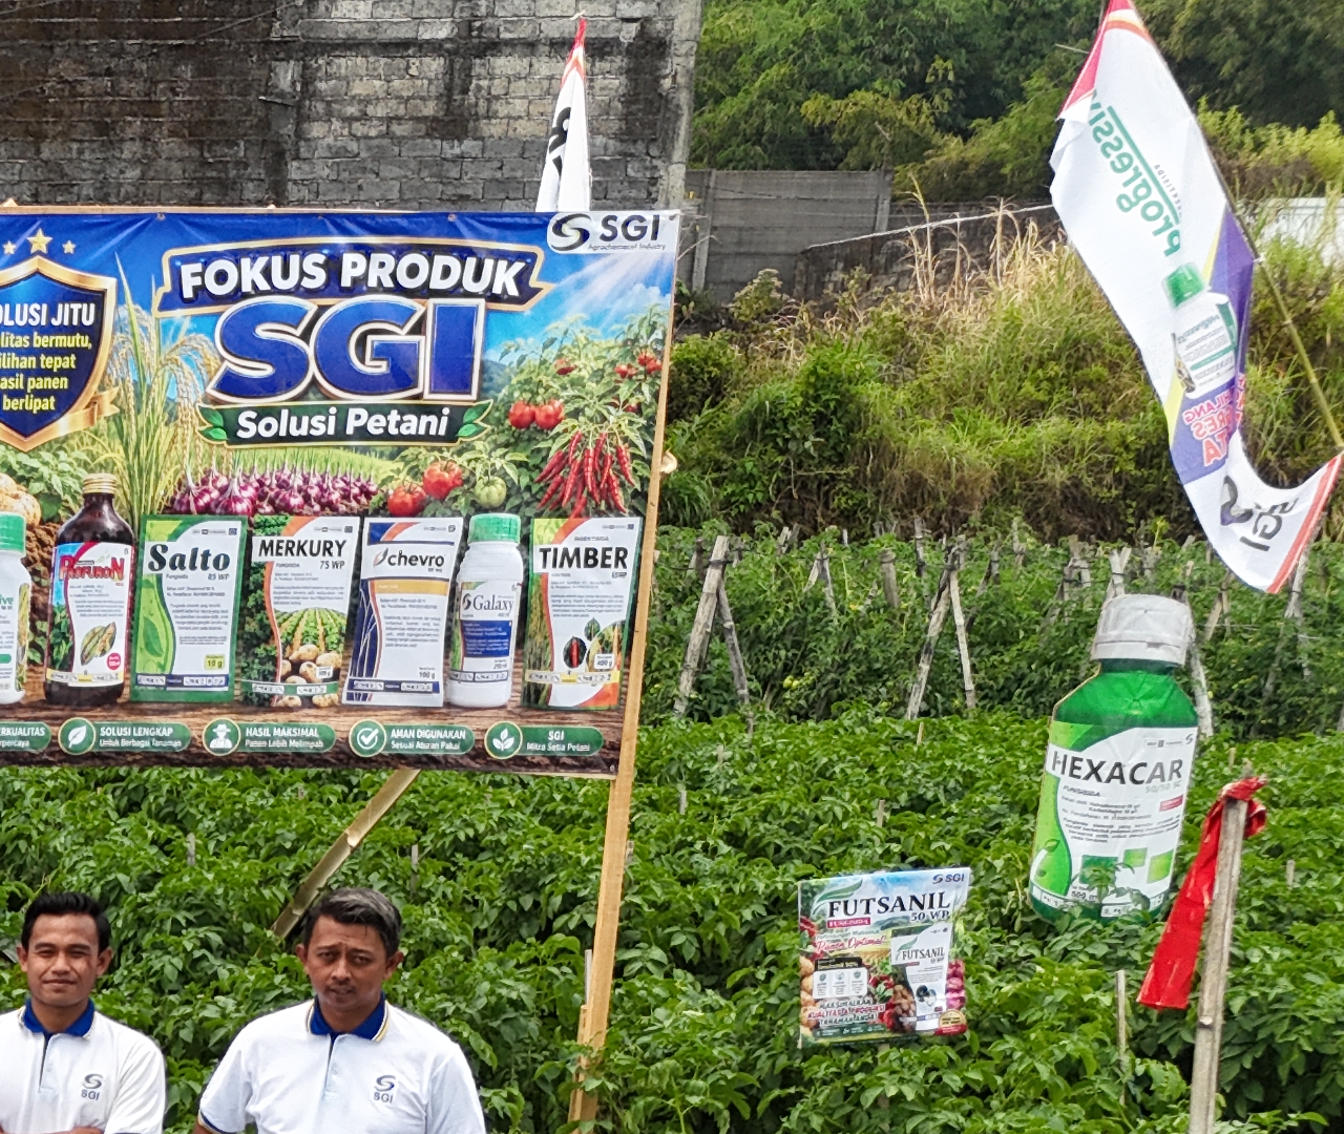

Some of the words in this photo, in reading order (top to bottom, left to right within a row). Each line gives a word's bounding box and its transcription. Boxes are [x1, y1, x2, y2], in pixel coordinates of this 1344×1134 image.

[599, 214, 660, 242] SGI
[180, 254, 327, 299] FOKUS
[340, 255, 527, 297] PRODUK
[50, 303, 95, 326] JITU
[33, 332, 92, 350] bermutu,
[207, 294, 487, 402] SGI
[40, 354, 76, 371] tepat
[27, 376, 68, 392] panen
[2, 394, 56, 412] berlipat
[236, 407, 338, 439] Solusi
[346, 408, 449, 437] Petani
[258, 539, 347, 557] MERKURY
[148, 544, 231, 572] Salto
[320, 560, 329, 570] 75
[331, 560, 345, 569] WP
[388, 551, 444, 567] chevro
[539, 547, 628, 569] TIMBER
[59, 555, 125, 581] PROFURON
[473, 595, 514, 612] Galaxy
[100, 727, 131, 737] SOLUSI
[132, 727, 173, 737] LENGKAP
[246, 727, 270, 738] HASIL
[273, 727, 319, 738] MAKSIMAL
[391, 728, 414, 739] AMAN
[416, 728, 466, 740] DIGUNAKAN
[548, 731, 565, 741] SGI
[1052, 751, 1183, 785] HEXACAR
[944, 873, 964, 882] SGI
[828, 891, 951, 918] FUTSANIL
[910, 913, 926, 922] 50
[930, 911, 950, 920] WP
[902, 947, 945, 960] FUTSANIL
[81, 1089, 100, 1101] SGI
[374, 1091, 394, 1103] SGI
